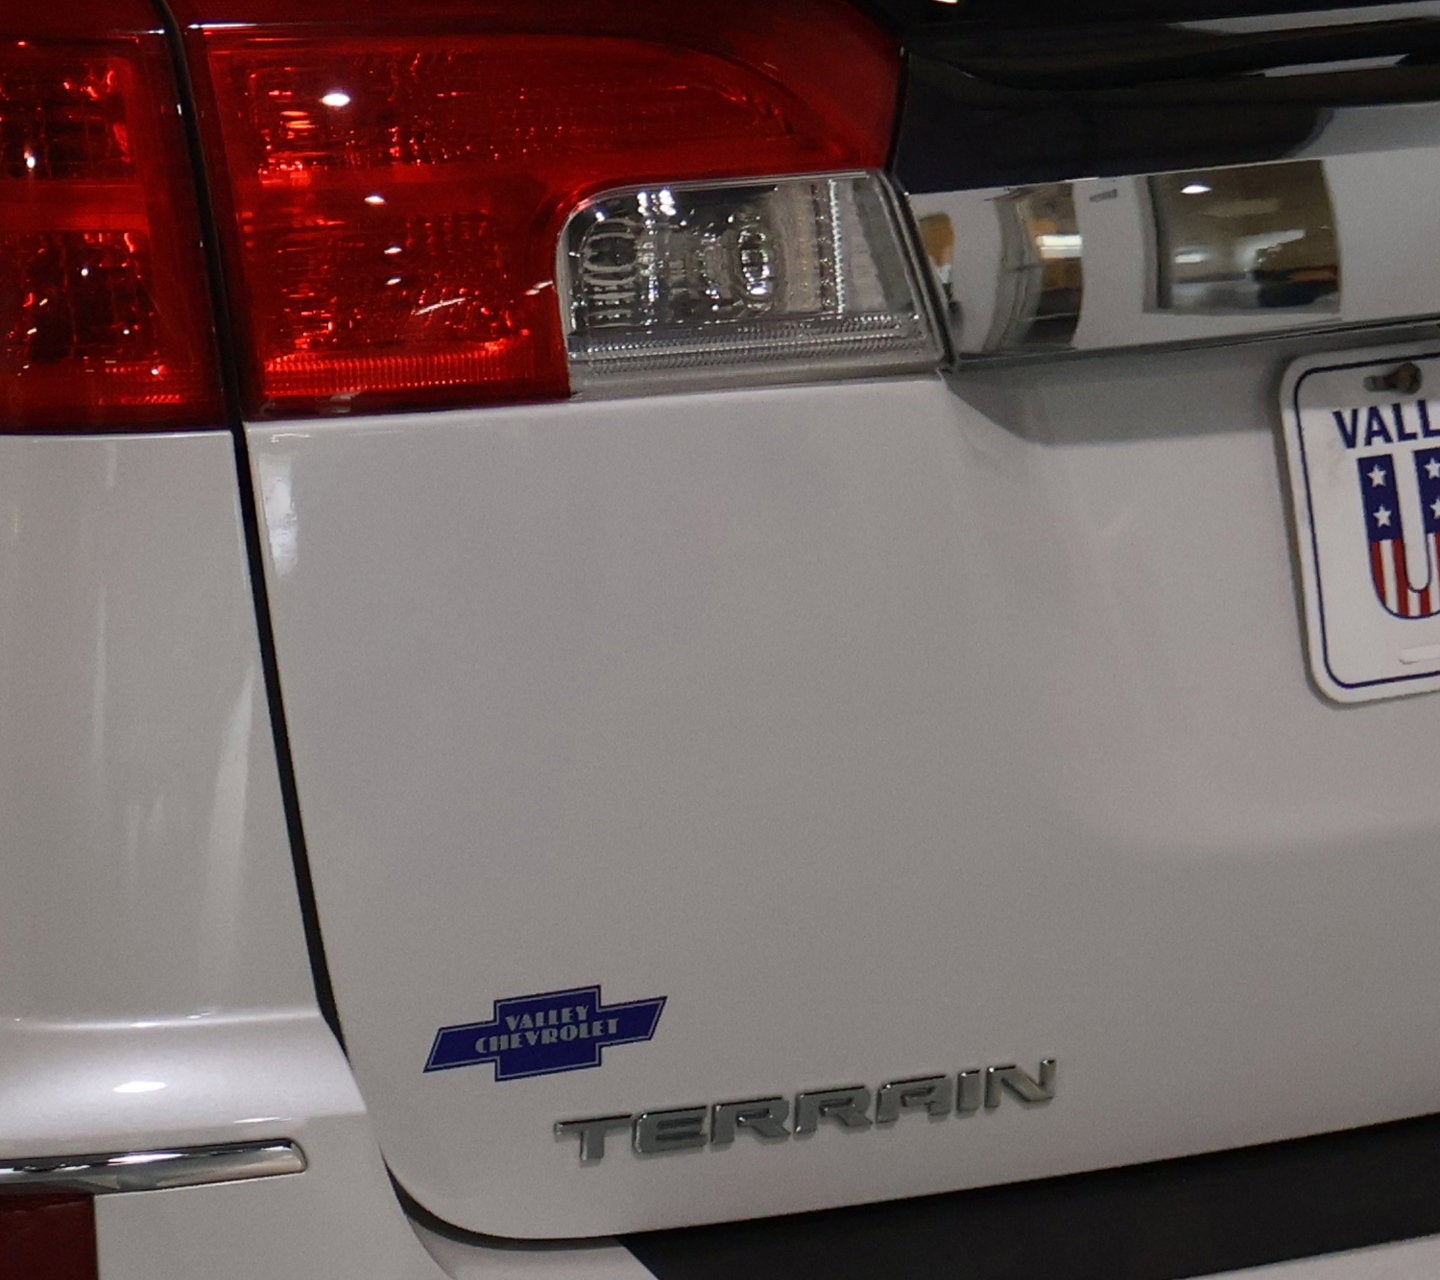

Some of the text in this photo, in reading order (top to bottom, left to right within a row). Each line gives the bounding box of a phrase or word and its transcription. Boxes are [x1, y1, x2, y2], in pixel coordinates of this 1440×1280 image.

[474, 1017, 621, 1055] CHEVROLET
[504, 1004, 591, 1032] VALLEY
[552, 1057, 1058, 1164] TERRAIN
